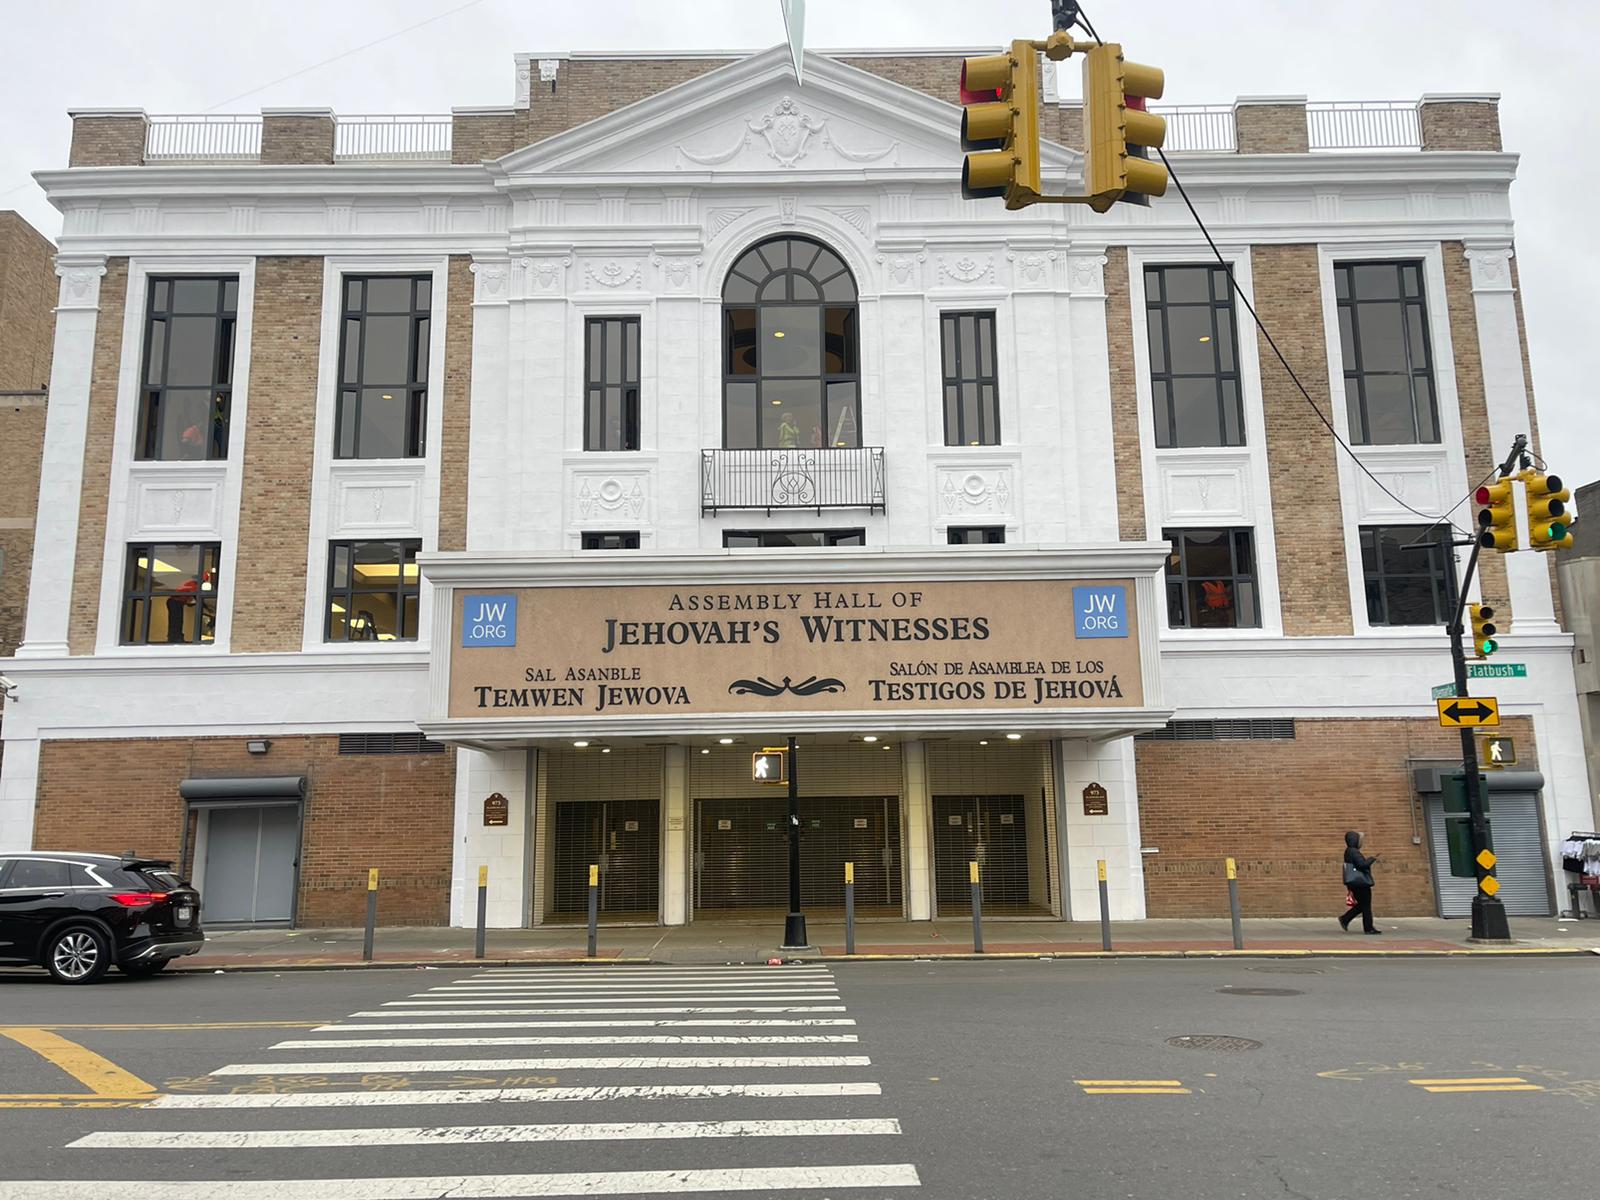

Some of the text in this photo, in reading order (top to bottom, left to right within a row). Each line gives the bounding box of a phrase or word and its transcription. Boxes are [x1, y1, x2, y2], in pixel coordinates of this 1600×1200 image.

[668, 591, 923, 611] ASSEMBLY HALL OF
[1084, 594, 1116, 613] JW
[473, 603, 507, 622] JW
[469, 624, 506, 639] .ORG
[1082, 615, 1118, 630] .ORG
[601, 615, 990, 653] JEHOVAH'S WITNESSES
[525, 666, 641, 682] SAL ASANBLE
[889, 660, 1104, 676] SALÓN DE ASAMBLEA DE LOS
[1467, 664, 1515, 677] Flatbush
[474, 684, 691, 711] TEMWEN JEWOVA
[868, 675, 1124, 705] TESTIGOS DE JEHOVÁ
